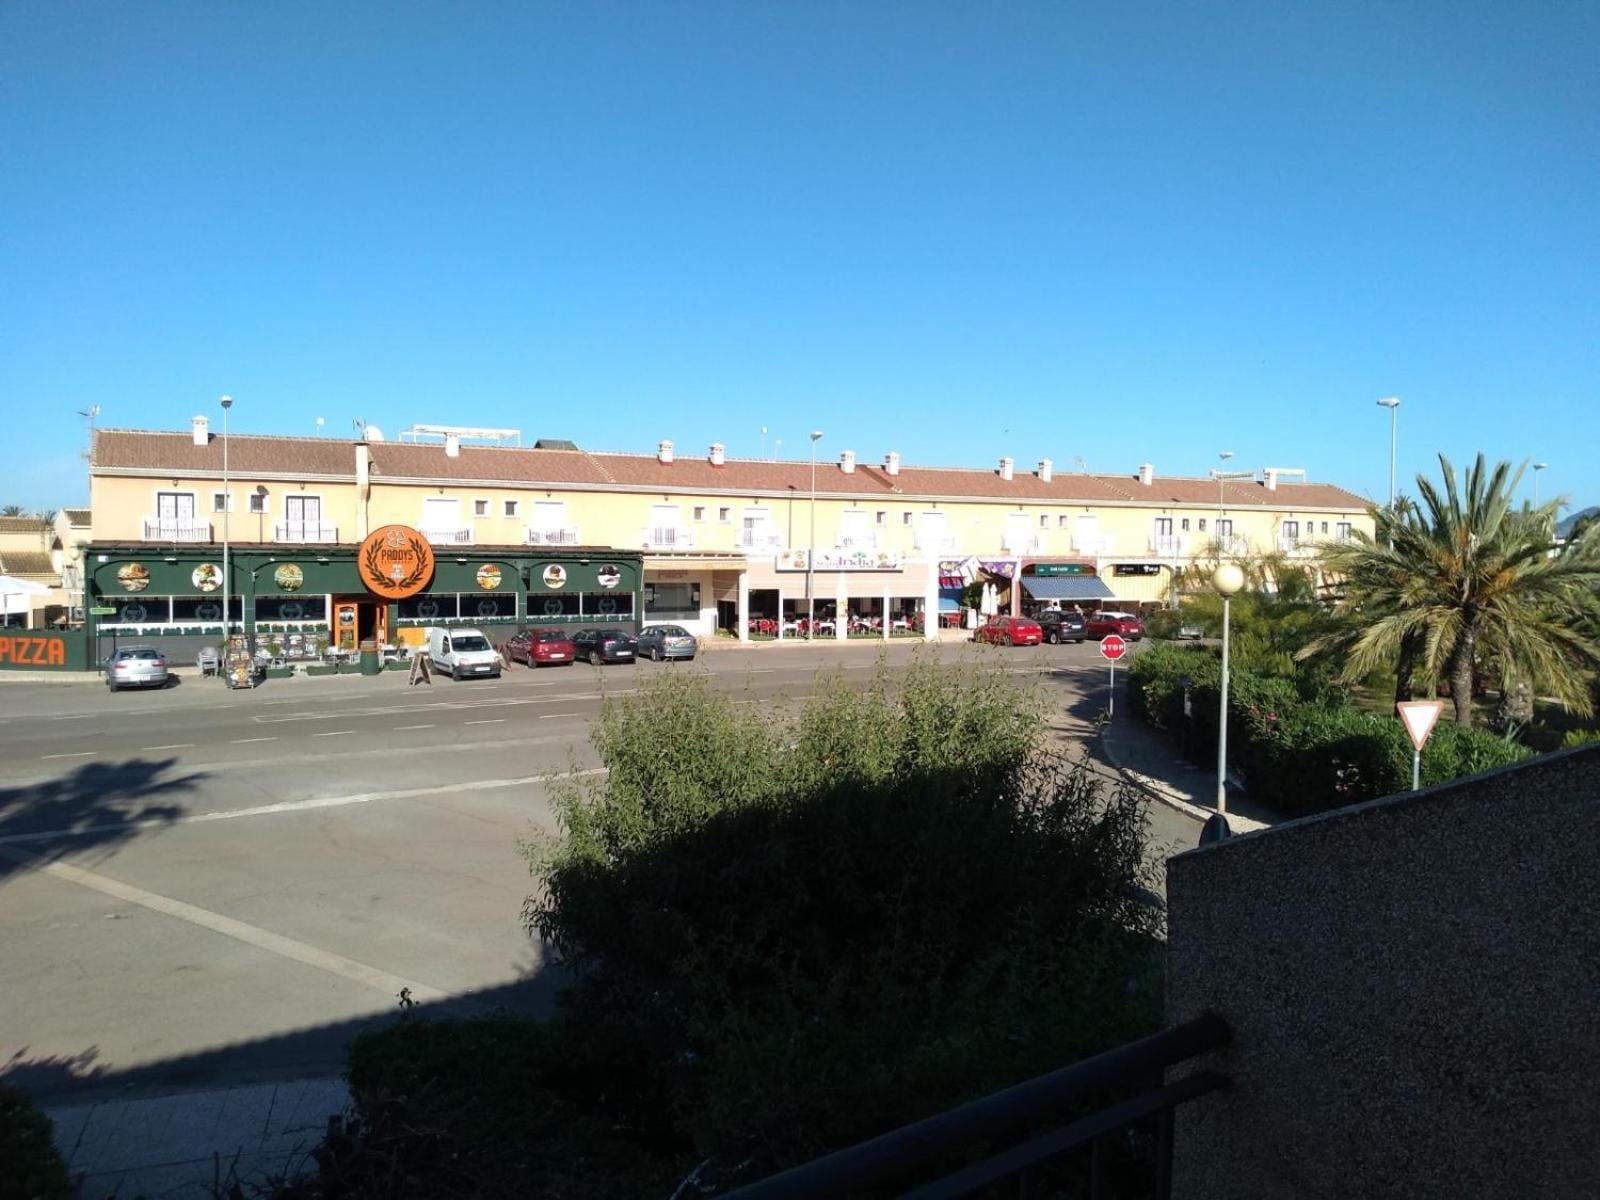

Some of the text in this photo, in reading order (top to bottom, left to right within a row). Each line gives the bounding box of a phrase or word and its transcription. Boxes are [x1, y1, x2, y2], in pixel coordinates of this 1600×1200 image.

[382, 549, 413, 560] PADDYS
[0, 636, 65, 665] PIZZA
[1102, 643, 1124, 651] STOP
